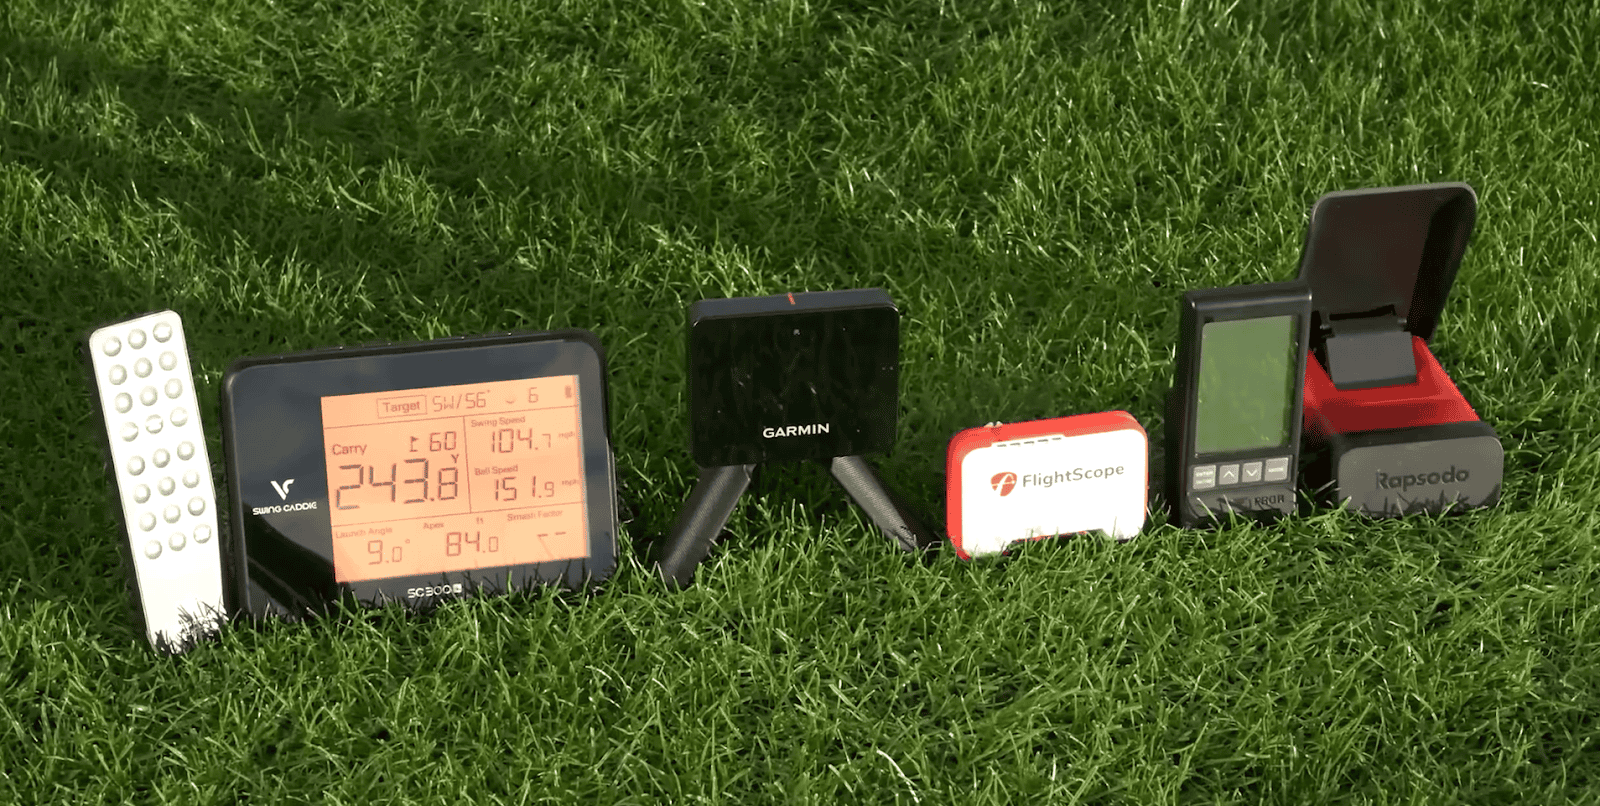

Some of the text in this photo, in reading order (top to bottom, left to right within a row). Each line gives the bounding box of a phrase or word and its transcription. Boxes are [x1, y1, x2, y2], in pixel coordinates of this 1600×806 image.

[382, 400, 421, 414] Target
[527, 387, 539, 403] 6
[471, 416, 526, 428] Swing Speed
[762, 423, 830, 439] GARMIN
[429, 431, 457, 452] 60
[491, 428, 551, 453] 104.7
[332, 444, 368, 457] Carry
[474, 464, 519, 476] Ball Speed
[1022, 465, 1125, 488] FlightScope
[336, 457, 459, 511] 243.8
[1376, 465, 1470, 492] Rapsodo
[252, 501, 318, 515] SWING CADDIE
[507, 509, 563, 522] Smash Factor
[335, 526, 393, 539] Launch Angle
[422, 521, 444, 531] Apex
[446, 530, 499, 557] 84.0
